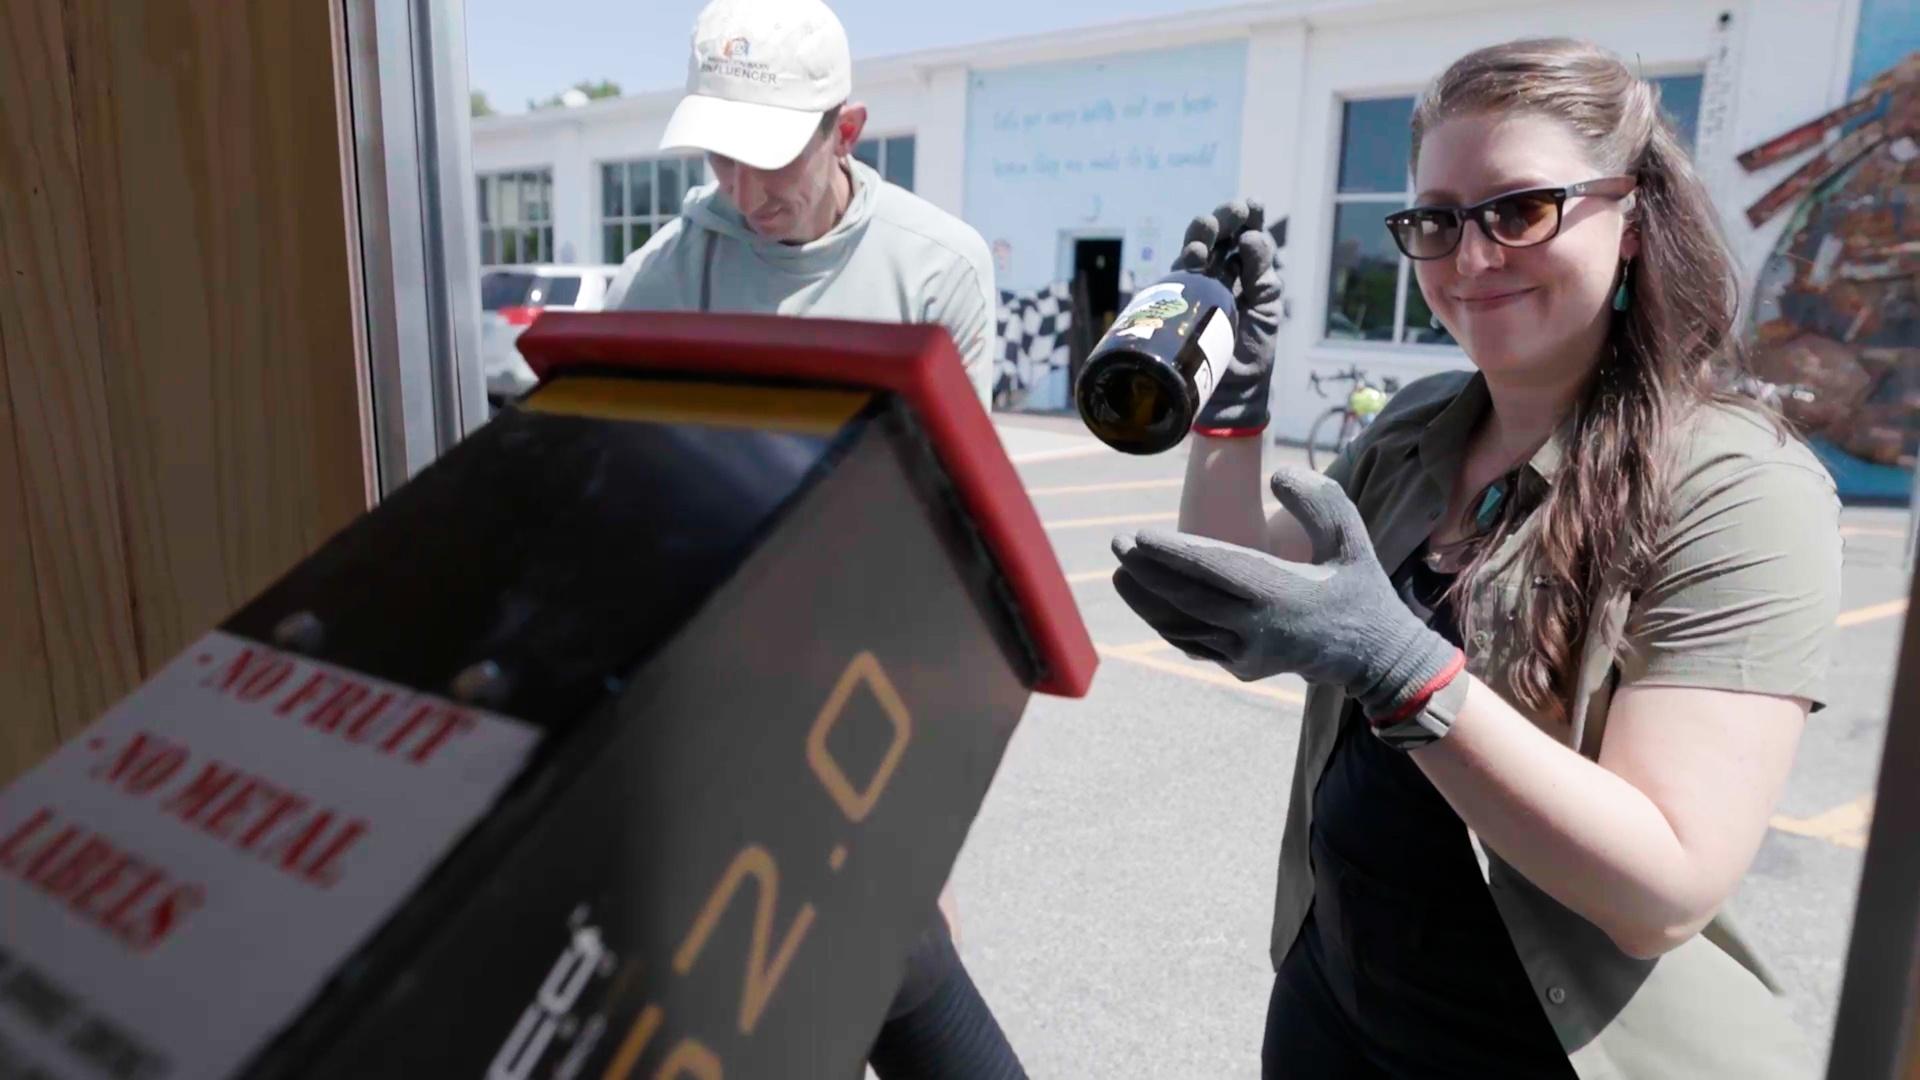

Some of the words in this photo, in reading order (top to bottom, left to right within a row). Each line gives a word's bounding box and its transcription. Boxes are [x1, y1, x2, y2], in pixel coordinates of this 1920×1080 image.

[700, 63, 777, 84] INFLUENCER
[219, 648, 295, 703] NO
[274, 670, 479, 766] FRUIT
[106, 731, 190, 796] NO
[163, 761, 370, 889] METAL
[0, 807, 206, 954] LABELS
